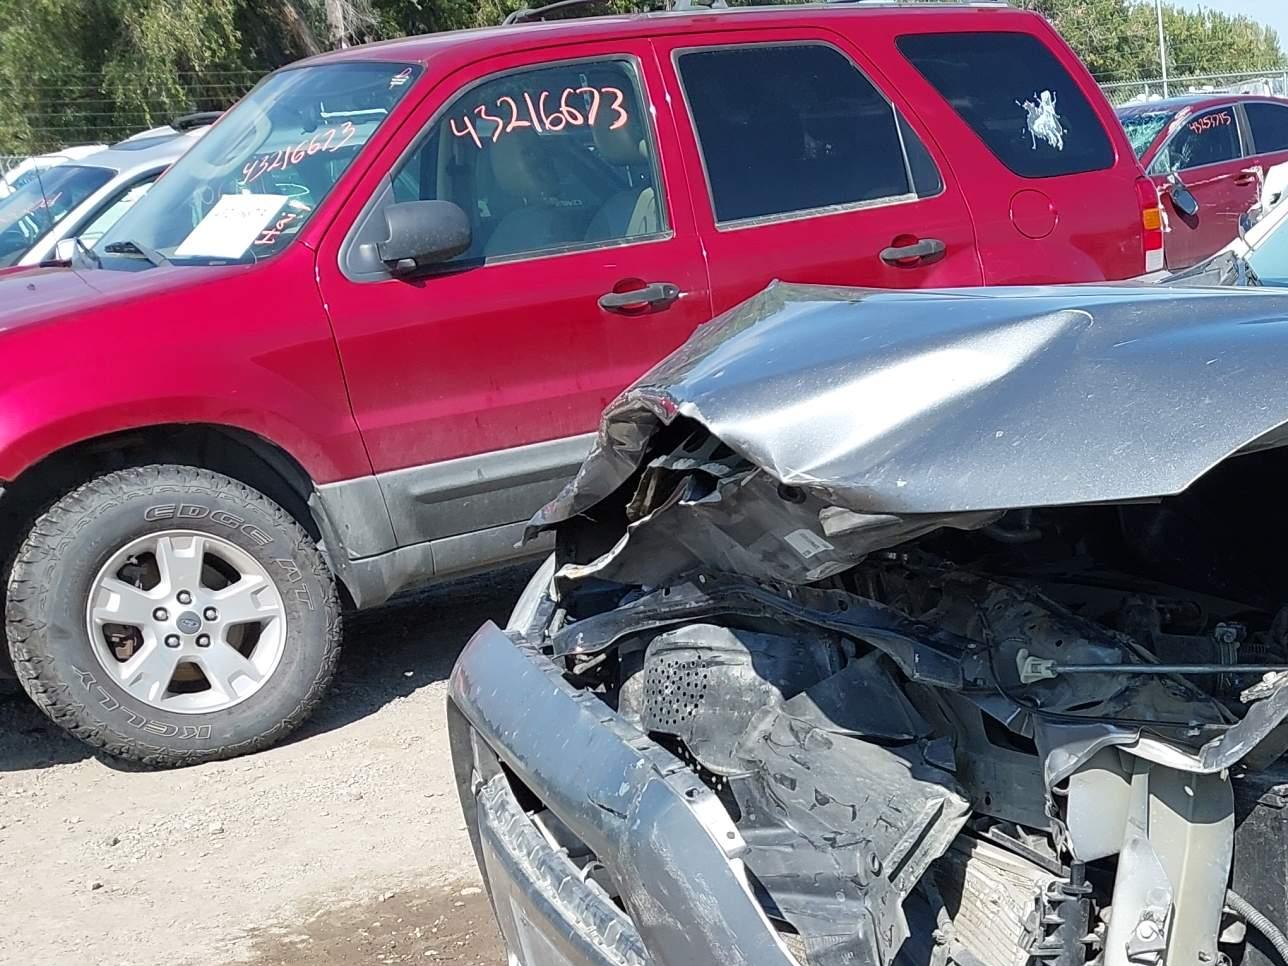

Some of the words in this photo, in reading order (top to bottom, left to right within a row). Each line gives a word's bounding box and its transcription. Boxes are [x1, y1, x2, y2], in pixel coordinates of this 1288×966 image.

[450, 87, 628, 149] 43216673
[238, 121, 356, 184] 43216673
[144, 503, 273, 546] EDGE
[71, 664, 212, 739] KELLY
